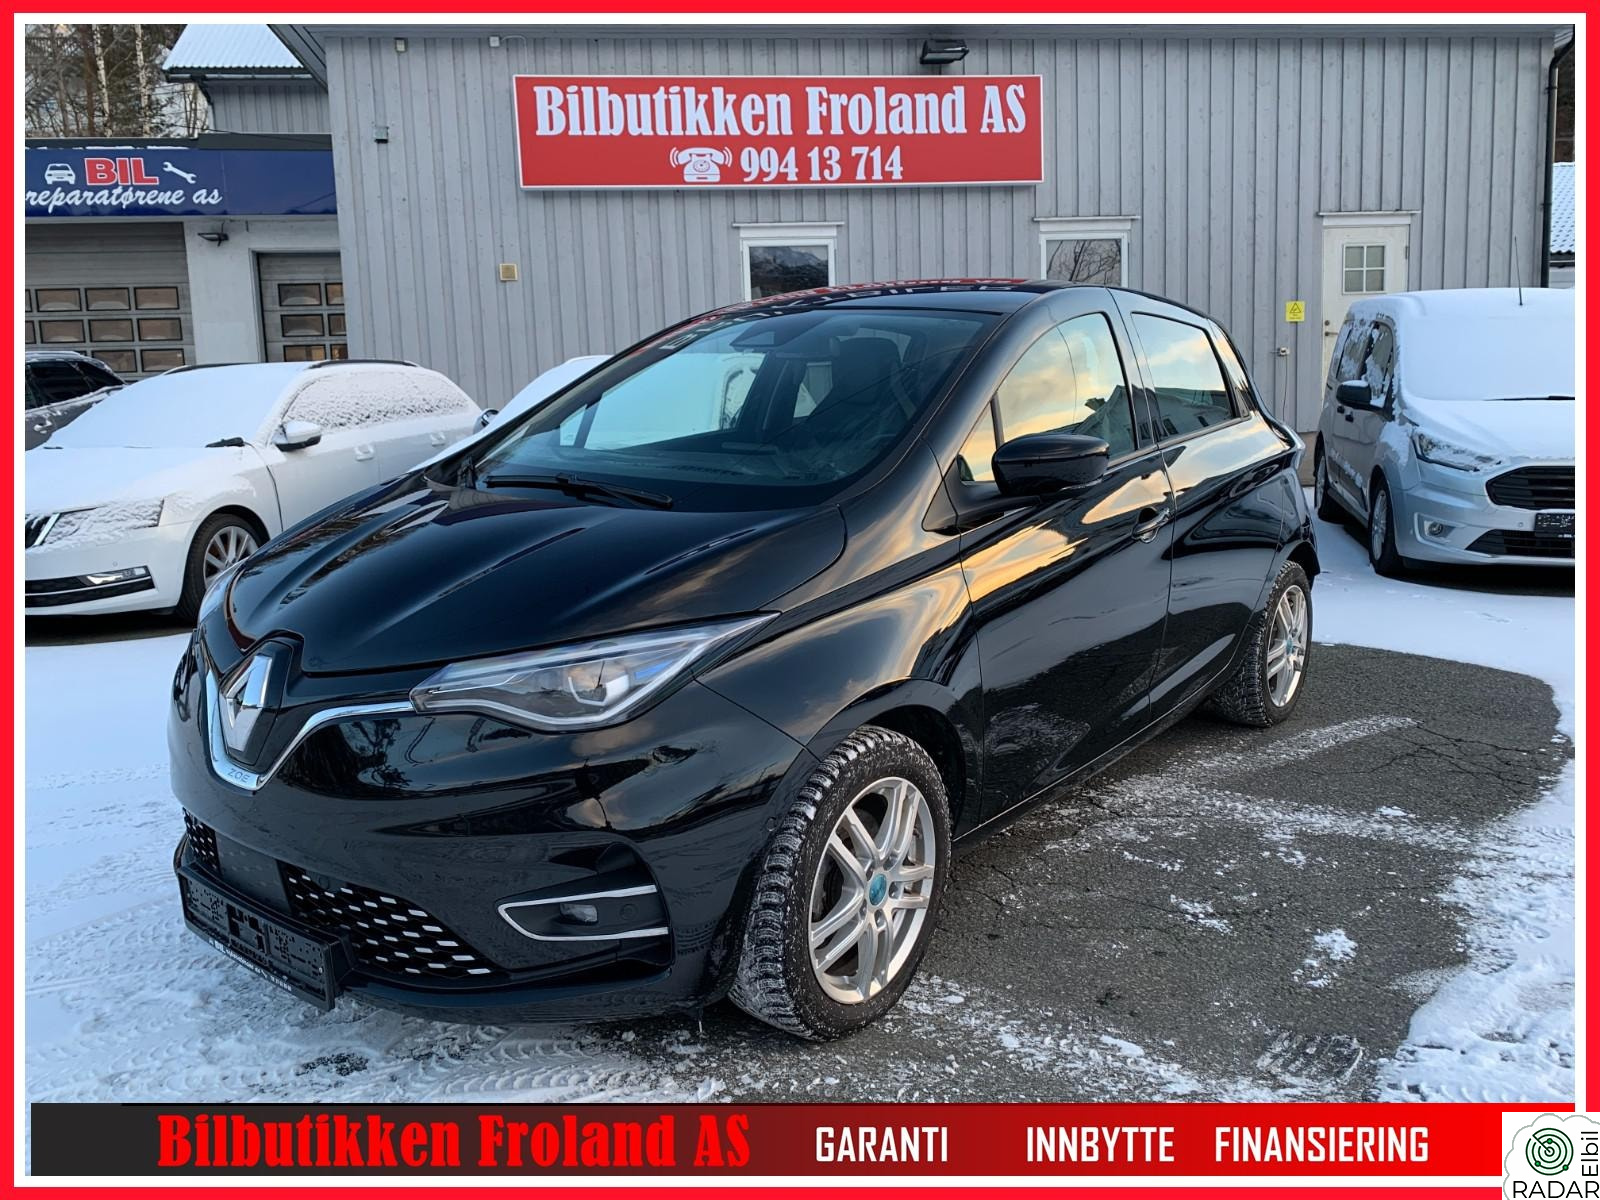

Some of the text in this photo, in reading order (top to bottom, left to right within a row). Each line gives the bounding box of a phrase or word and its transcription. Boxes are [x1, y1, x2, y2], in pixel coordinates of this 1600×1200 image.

[534, 84, 1026, 136] Bilbutikken Froland AS
[84, 157, 159, 186] BIL
[740, 145, 903, 182] 994 13 714
[25, 186, 223, 214] reparatørene as
